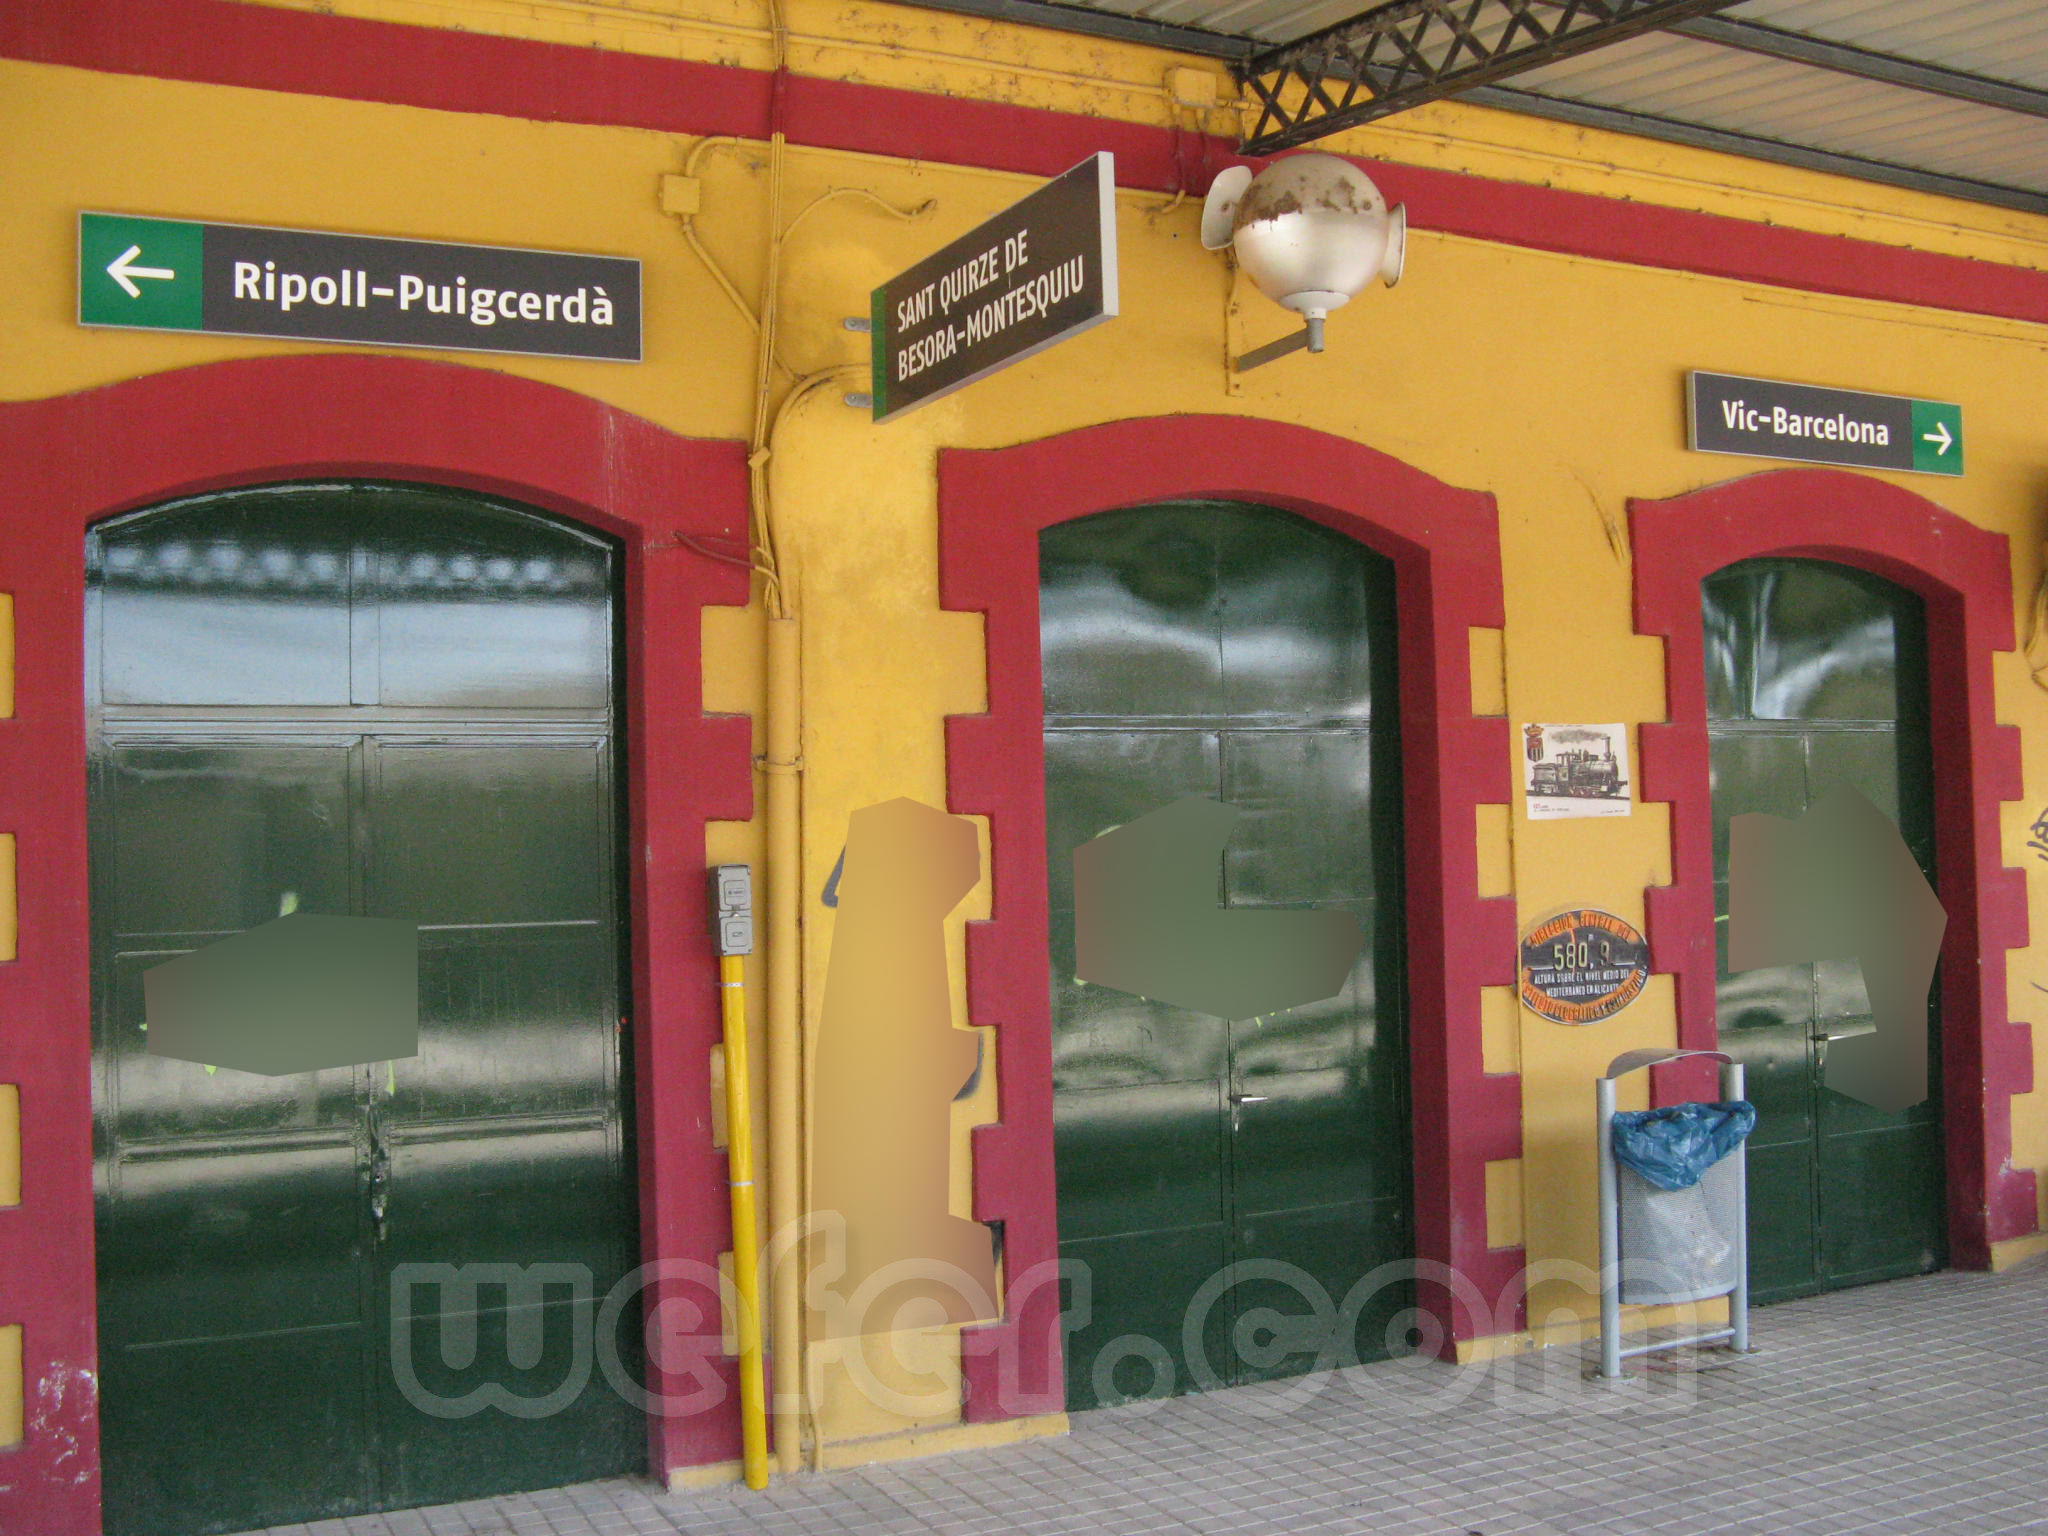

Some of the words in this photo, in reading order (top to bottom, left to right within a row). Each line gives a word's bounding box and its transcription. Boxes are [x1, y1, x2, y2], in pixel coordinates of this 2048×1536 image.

[233, 261, 614, 327] Ripoll-Puigcerdà
[897, 283, 935, 332] SANT
[940, 245, 999, 315] QUIRZE
[1004, 228, 1028, 273] DE
[898, 254, 1084, 382] BESORA-MONTESQUIU
[1721, 400, 1889, 447] Vic-Barcelona
[1534, 973, 1555, 984] ALTURA
[1556, 972, 1575, 983] SOBRE
[1576, 972, 1583, 982] EL
[1585, 971, 1601, 981] NIVEL
[1603, 970, 1619, 980] MEDIO
[1620, 969, 1629, 979] DEL
[1586, 985, 1593, 995] EN
